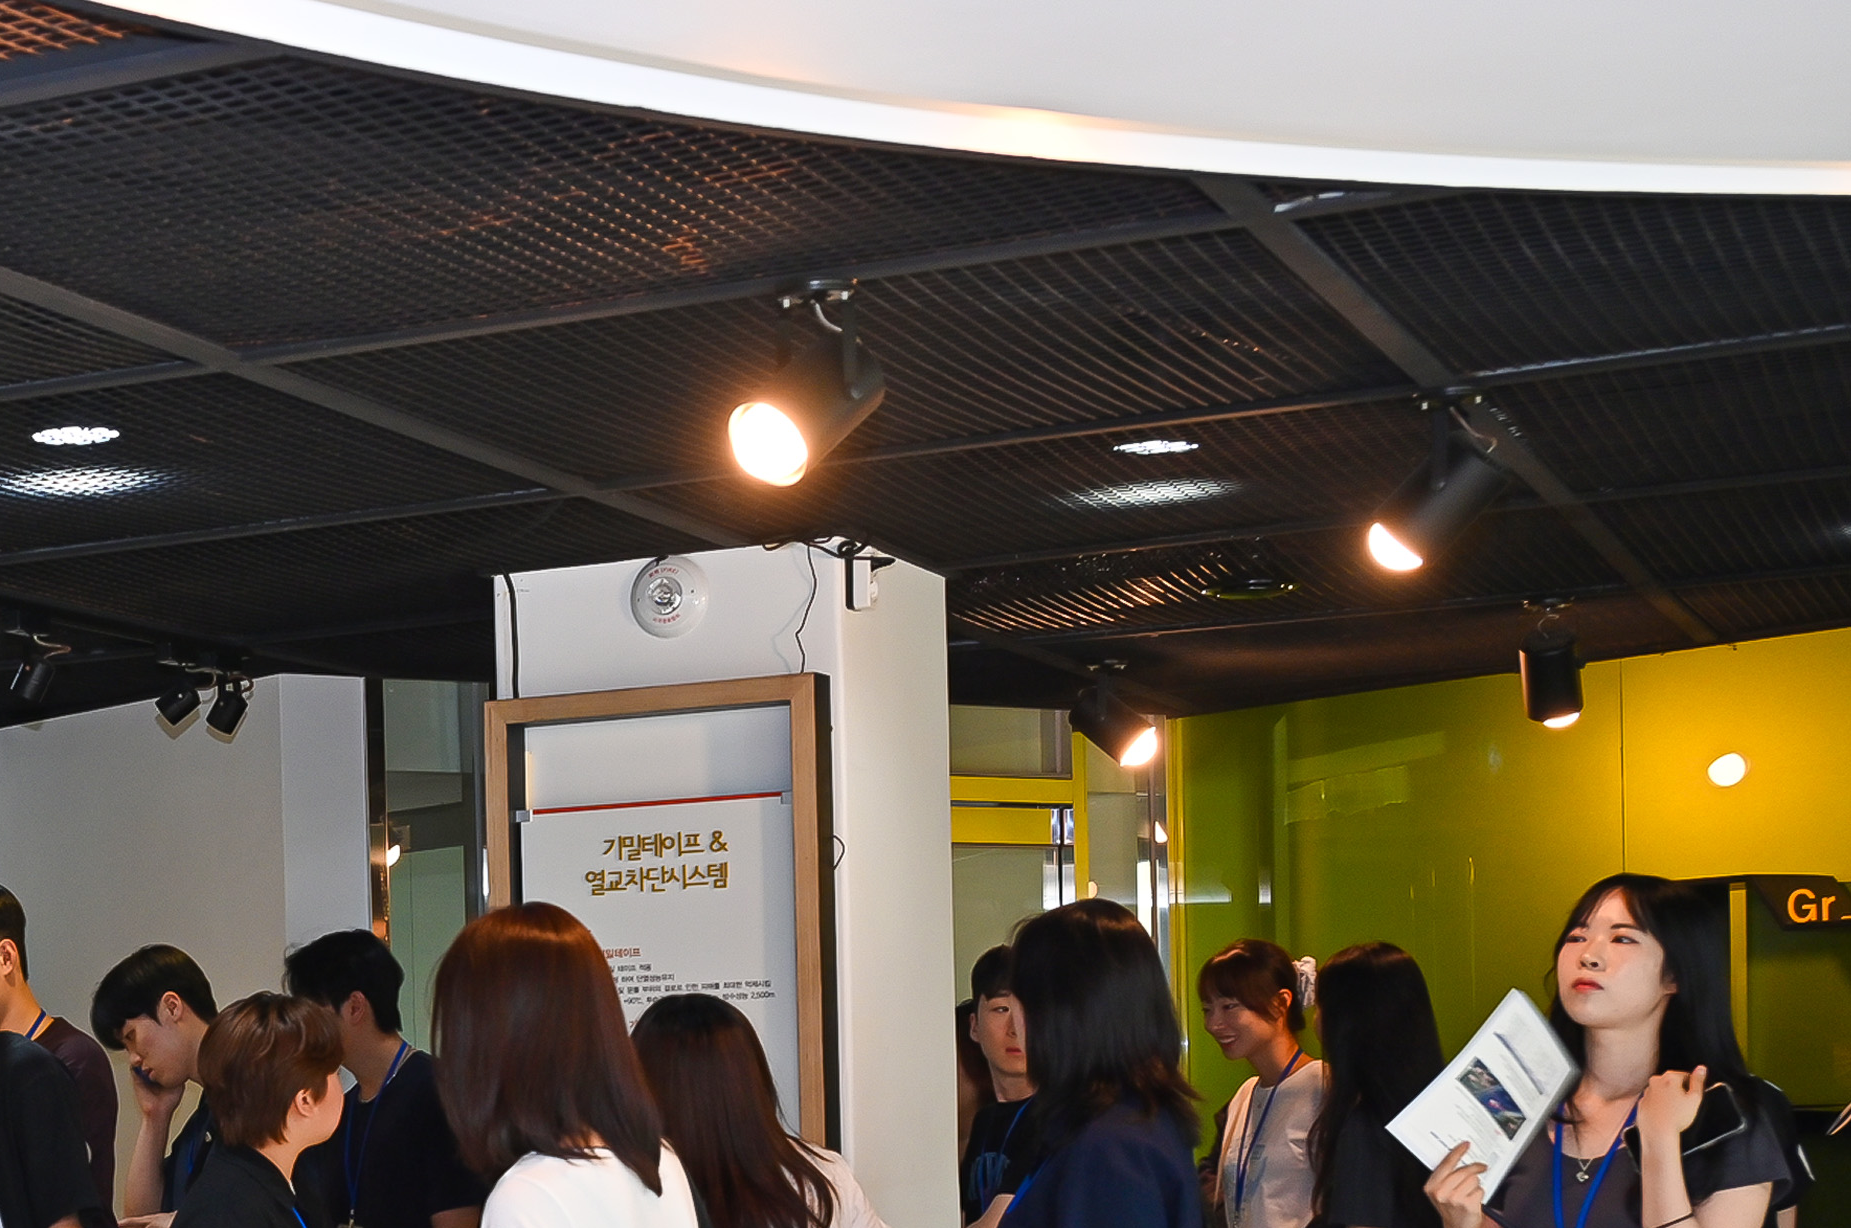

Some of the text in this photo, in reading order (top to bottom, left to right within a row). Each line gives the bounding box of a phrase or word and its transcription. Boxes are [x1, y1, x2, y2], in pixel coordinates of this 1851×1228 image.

[602, 830, 729, 861] 기밀테이프 &
[584, 861, 729, 896] 열교차단시스템
